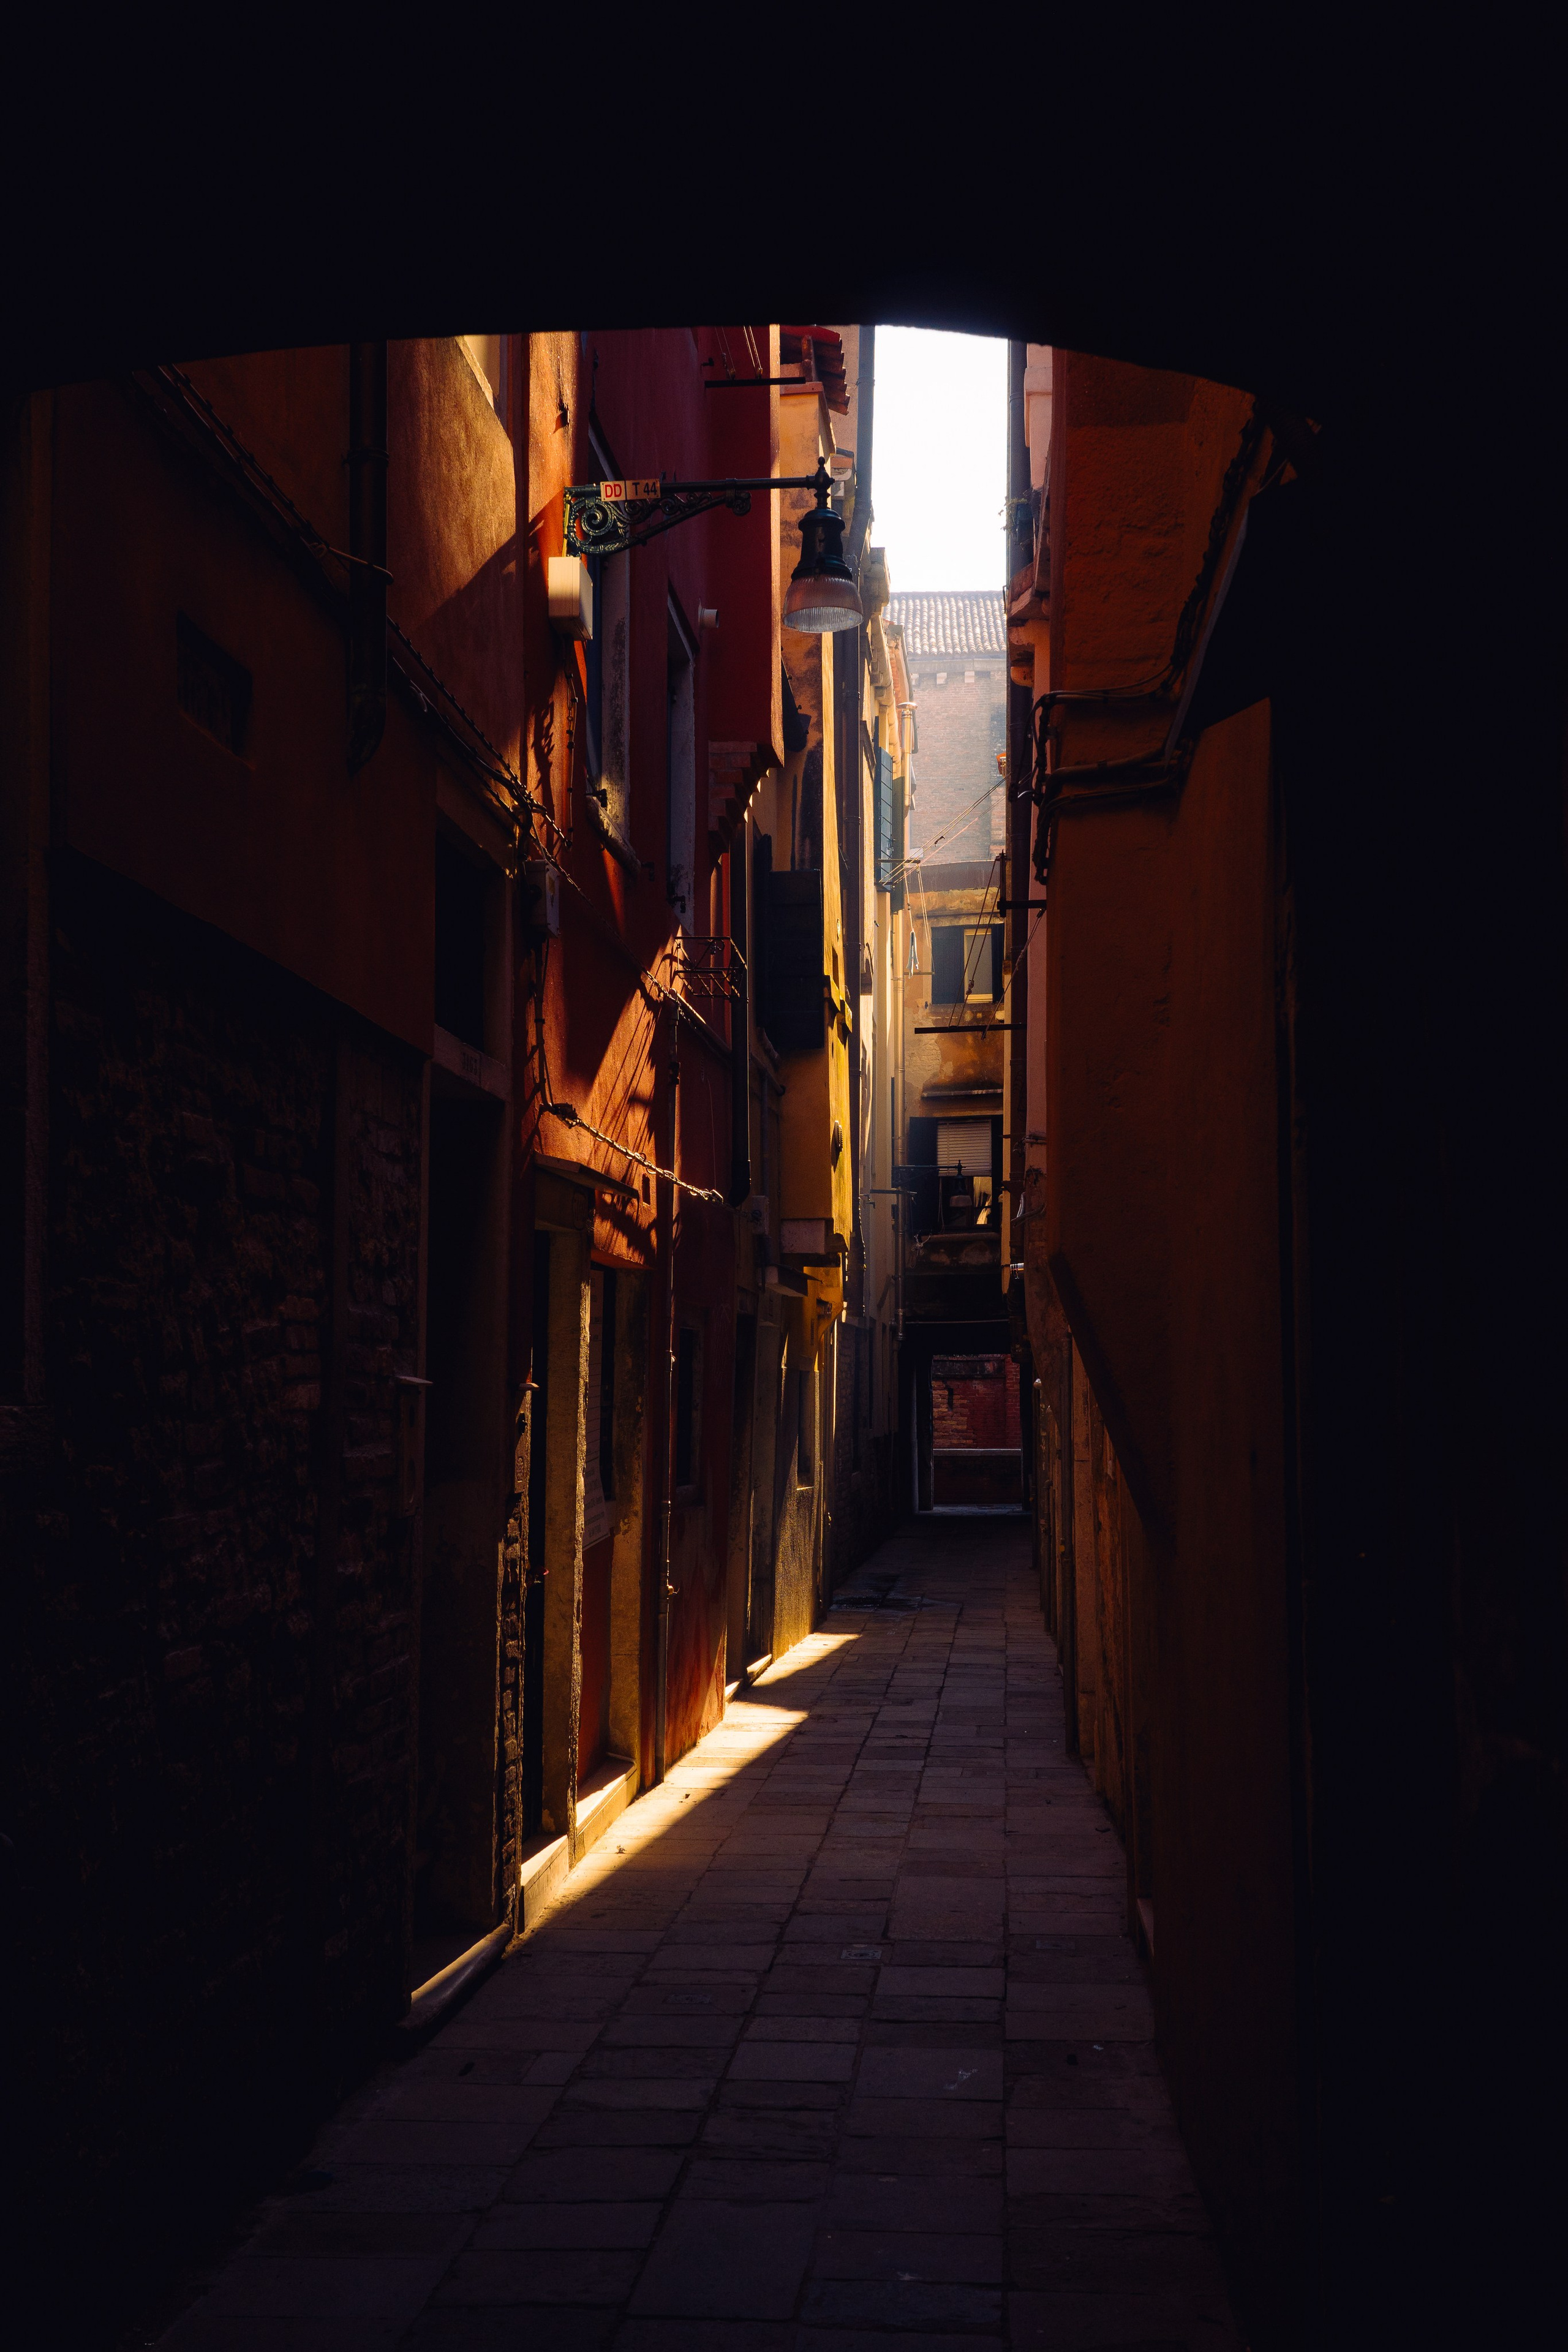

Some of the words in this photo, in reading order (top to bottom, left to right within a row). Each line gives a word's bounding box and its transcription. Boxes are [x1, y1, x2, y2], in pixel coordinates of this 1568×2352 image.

[605, 484, 622, 497] DD
[632, 482, 639, 496] T
[643, 481, 657, 496] 44
